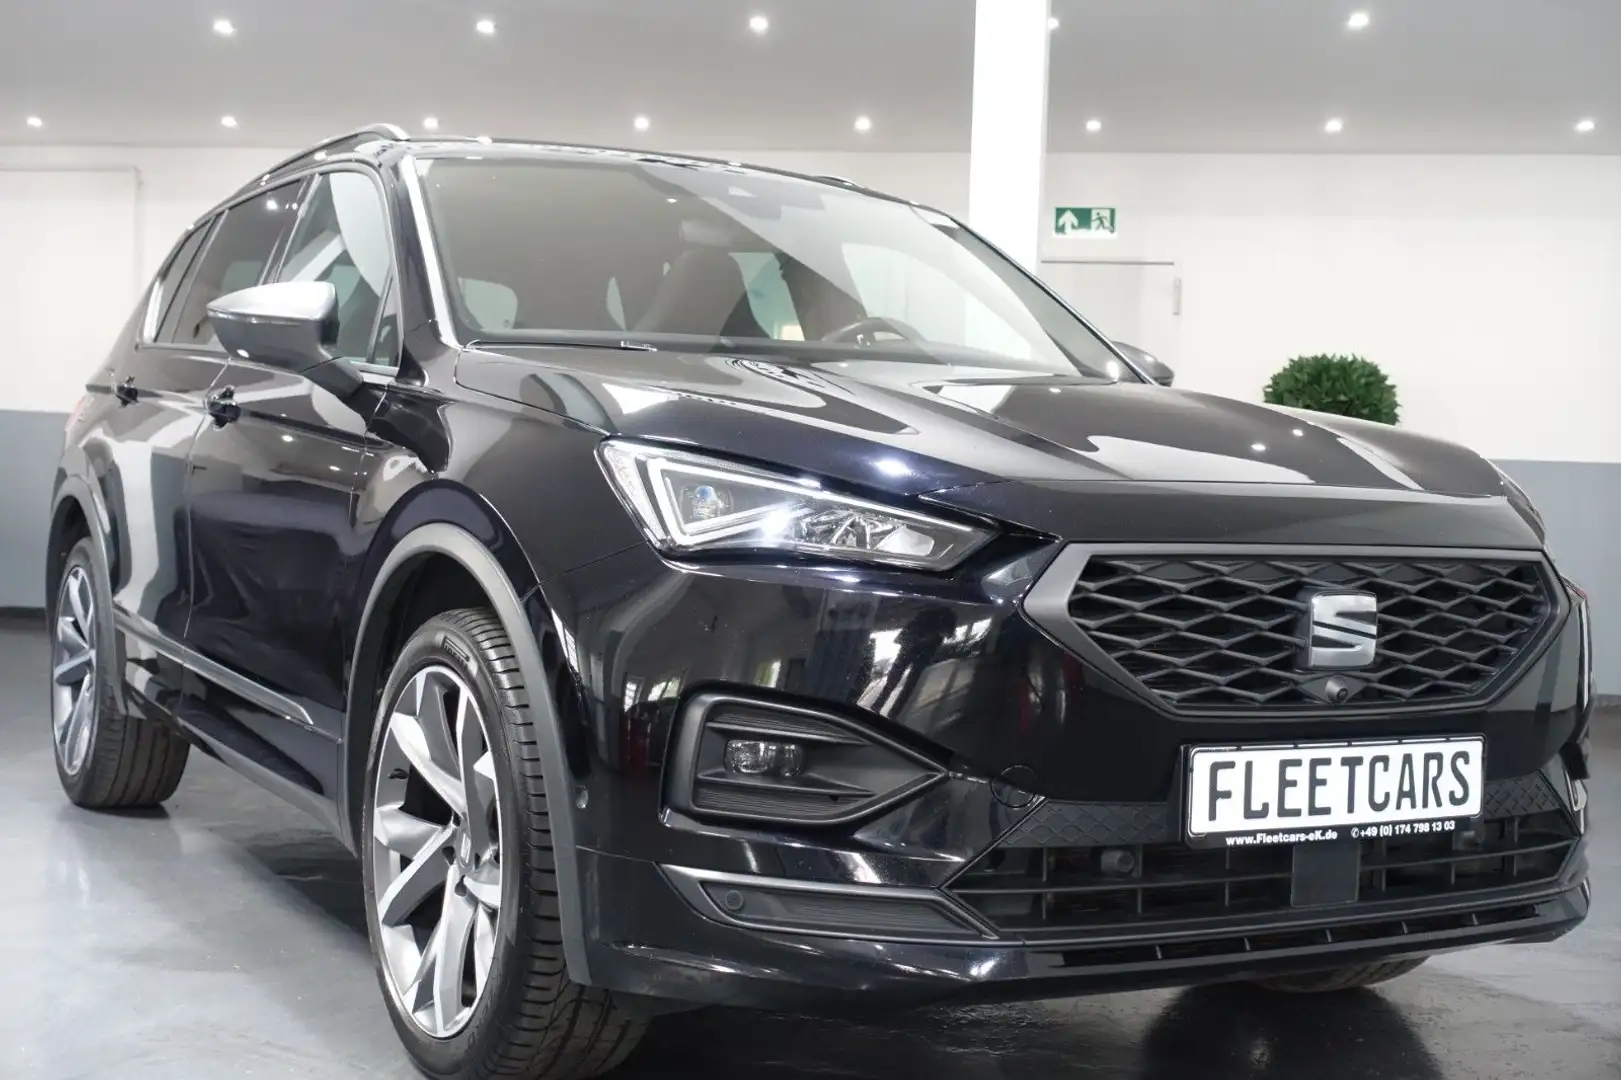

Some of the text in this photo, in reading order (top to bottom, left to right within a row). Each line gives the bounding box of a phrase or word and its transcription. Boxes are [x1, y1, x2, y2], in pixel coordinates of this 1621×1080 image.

[1208, 750, 1470, 821] FLEETCARS
[1360, 826, 1378, 837] +49
[1394, 823, 1411, 834] 174
[1413, 822, 1430, 833] 798
[1432, 821, 1442, 831] 13
[1443, 820, 1455, 831] 03
